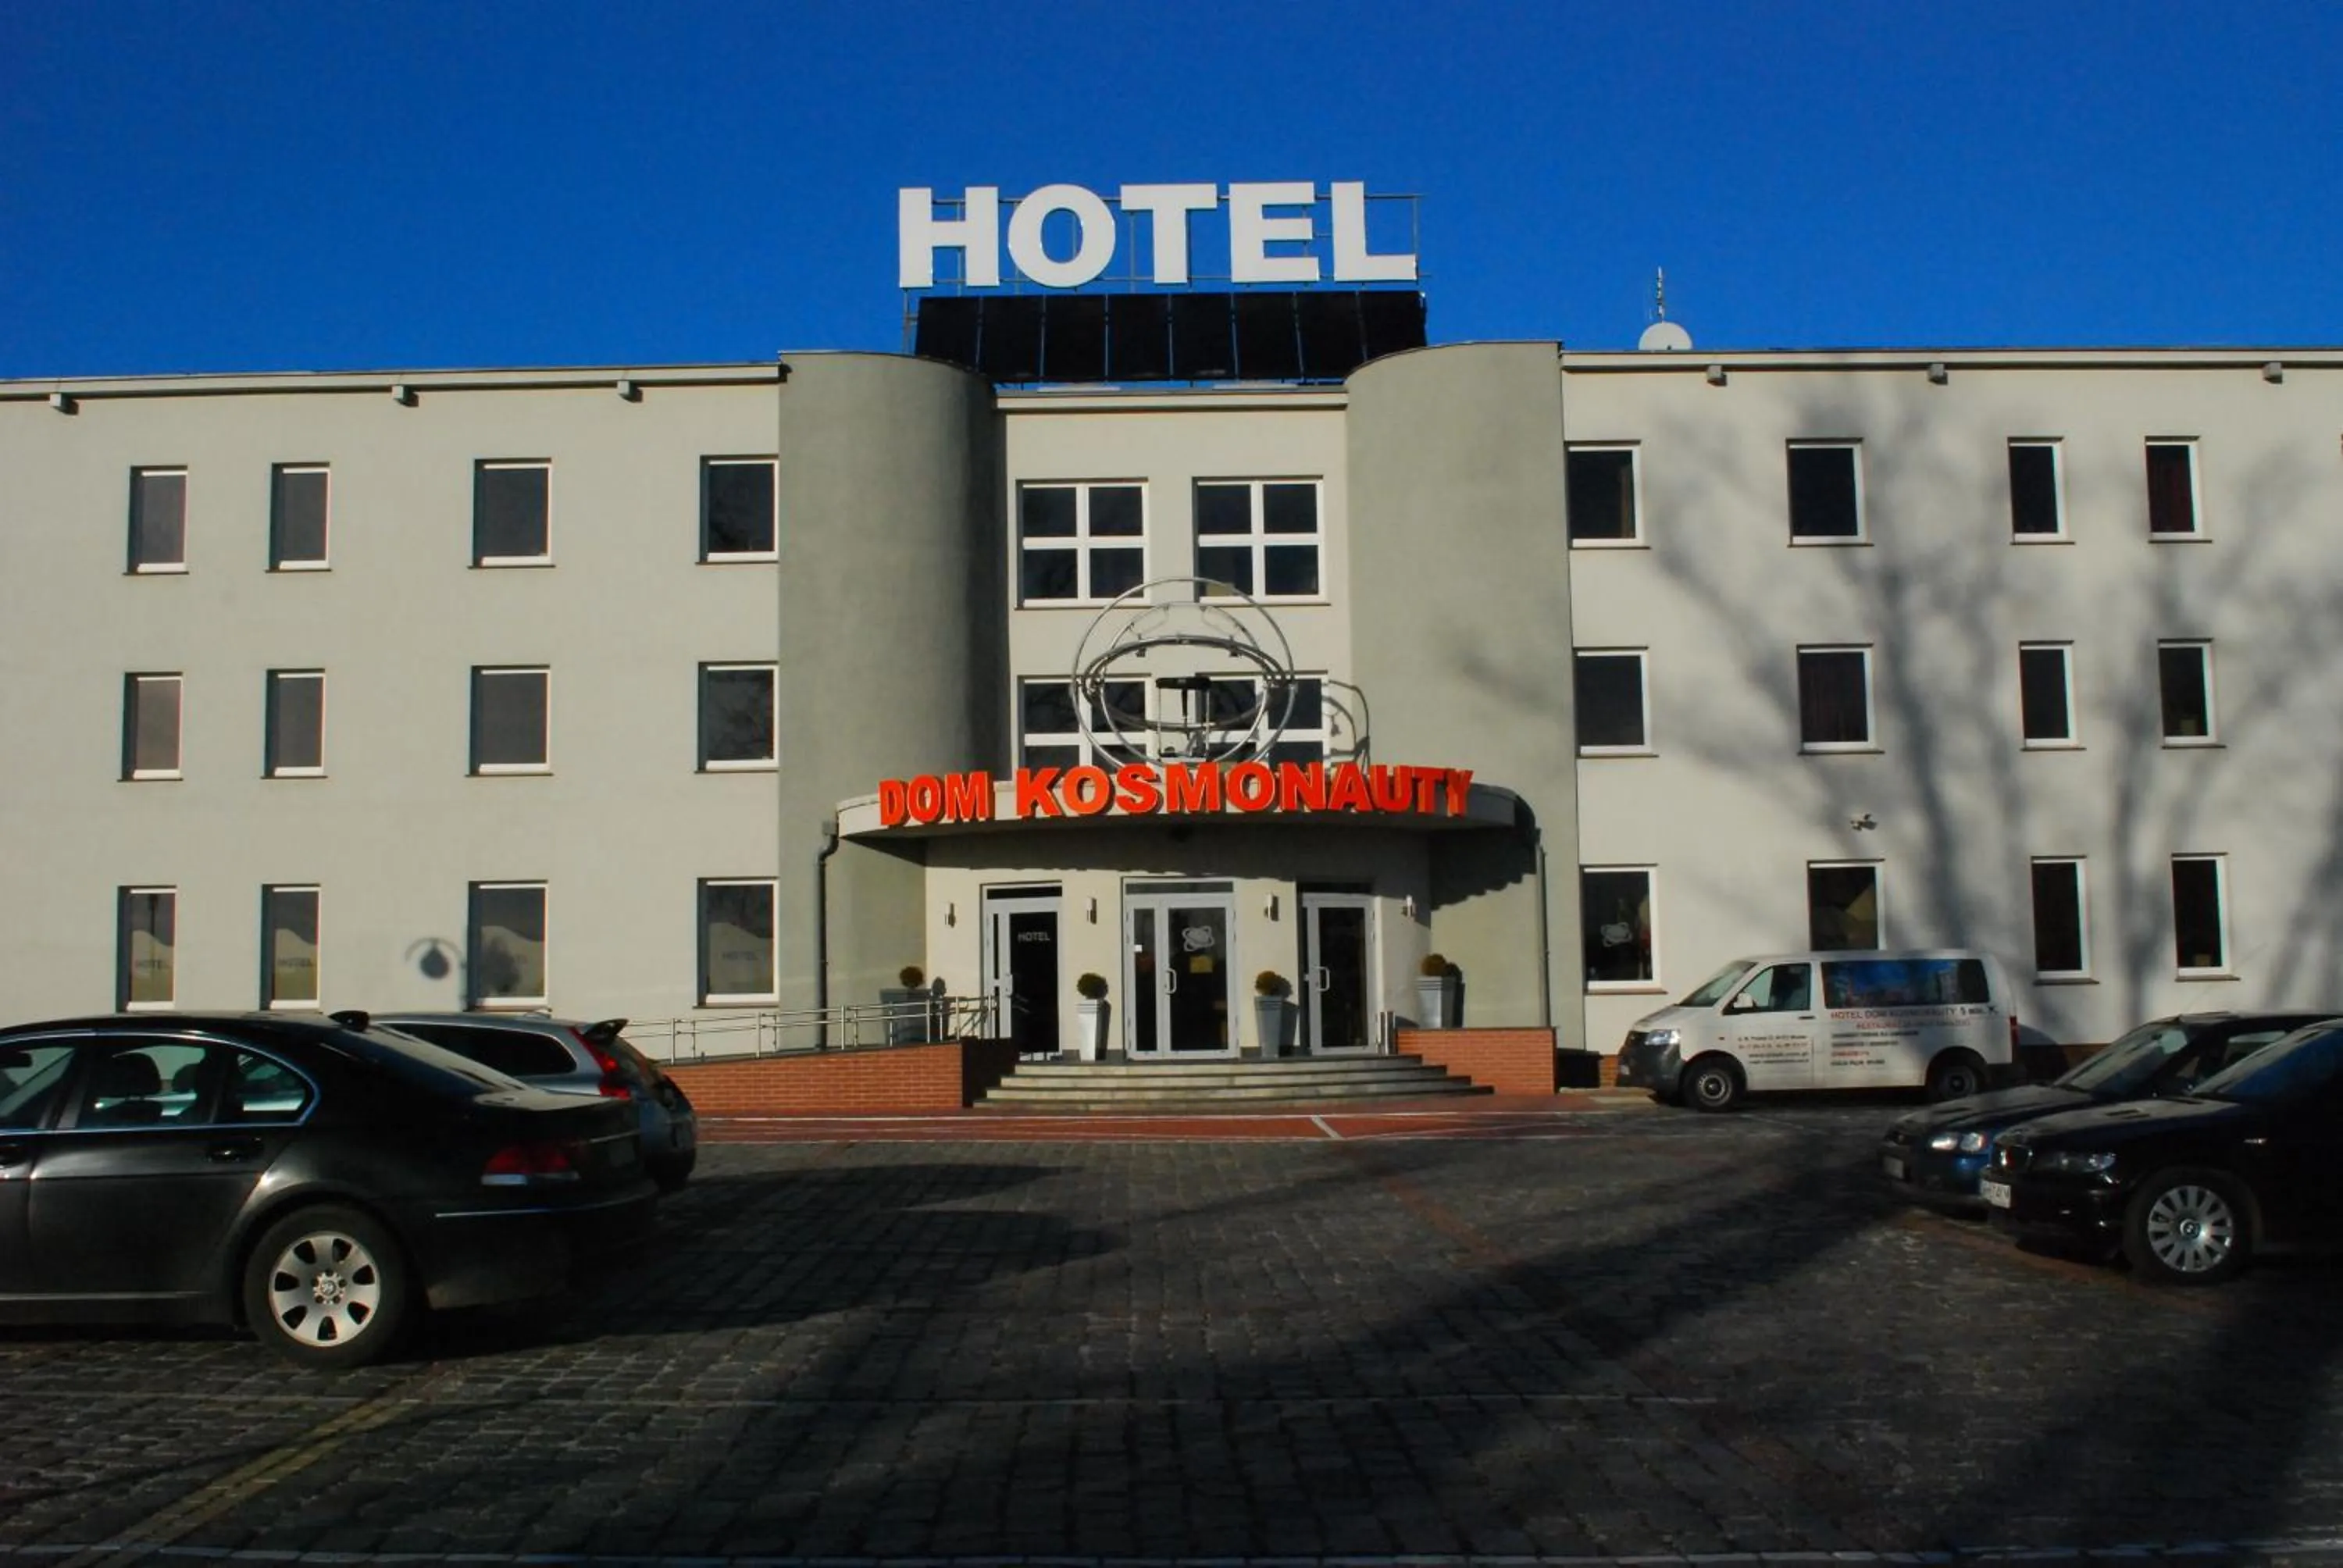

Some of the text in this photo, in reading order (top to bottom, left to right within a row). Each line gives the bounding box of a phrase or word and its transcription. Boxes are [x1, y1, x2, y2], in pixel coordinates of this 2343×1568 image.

[899, 183, 1417, 287] HOTEL
[878, 761, 1474, 825] DOM KOSMONAUTY
[1018, 932, 1050, 943] HOTEL
[1831, 1011, 1863, 1020] HOTEL
